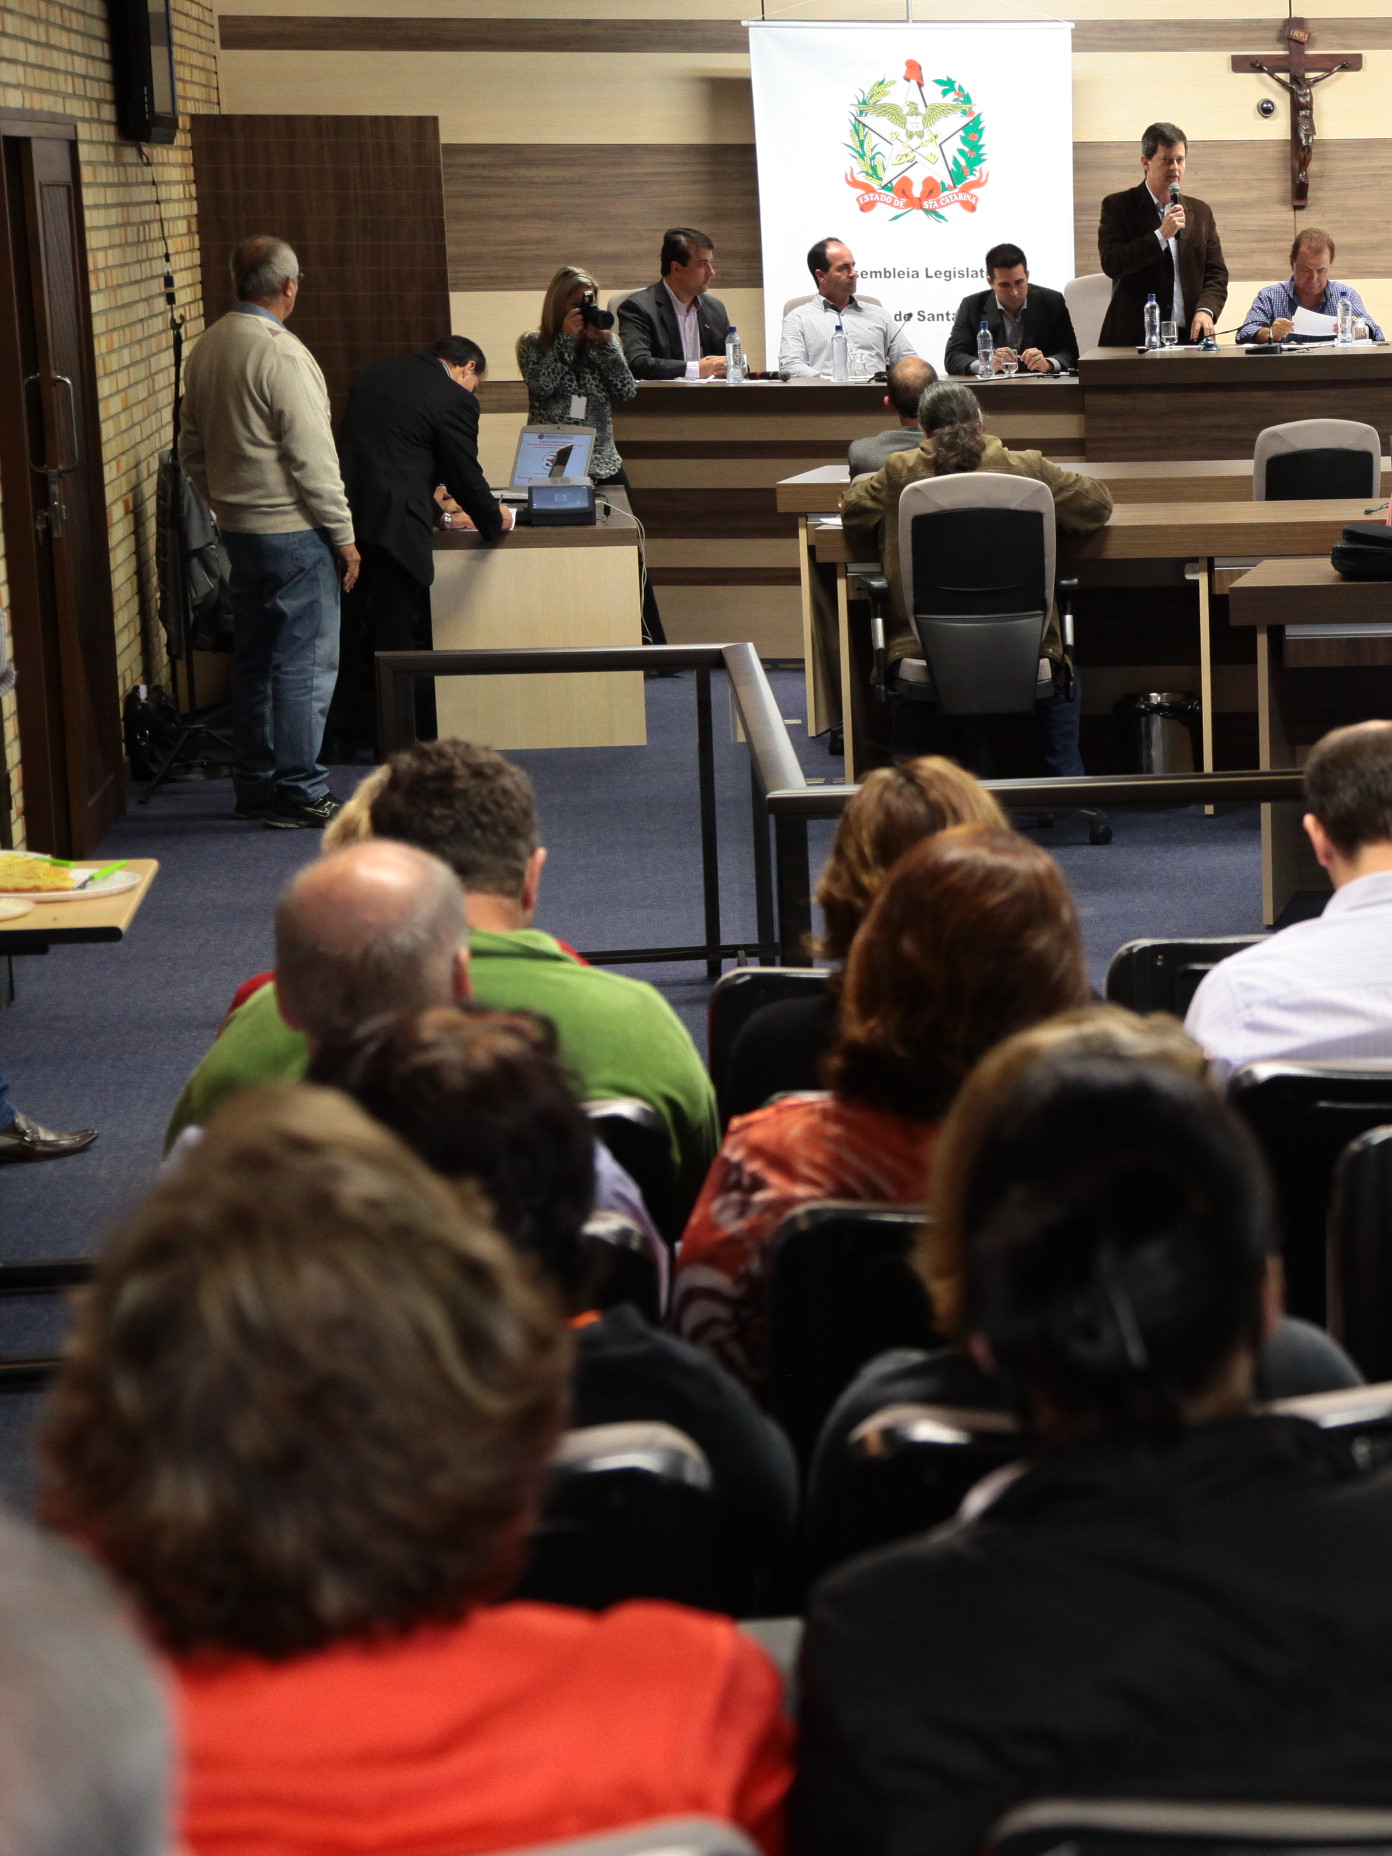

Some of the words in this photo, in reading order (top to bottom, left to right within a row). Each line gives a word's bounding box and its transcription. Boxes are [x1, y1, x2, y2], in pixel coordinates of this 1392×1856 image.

[1290, 29, 1309, 41] INRI
[859, 193, 892, 205] ESTADO
[893, 198, 905, 209] DE
[925, 267, 987, 282] Legislat
